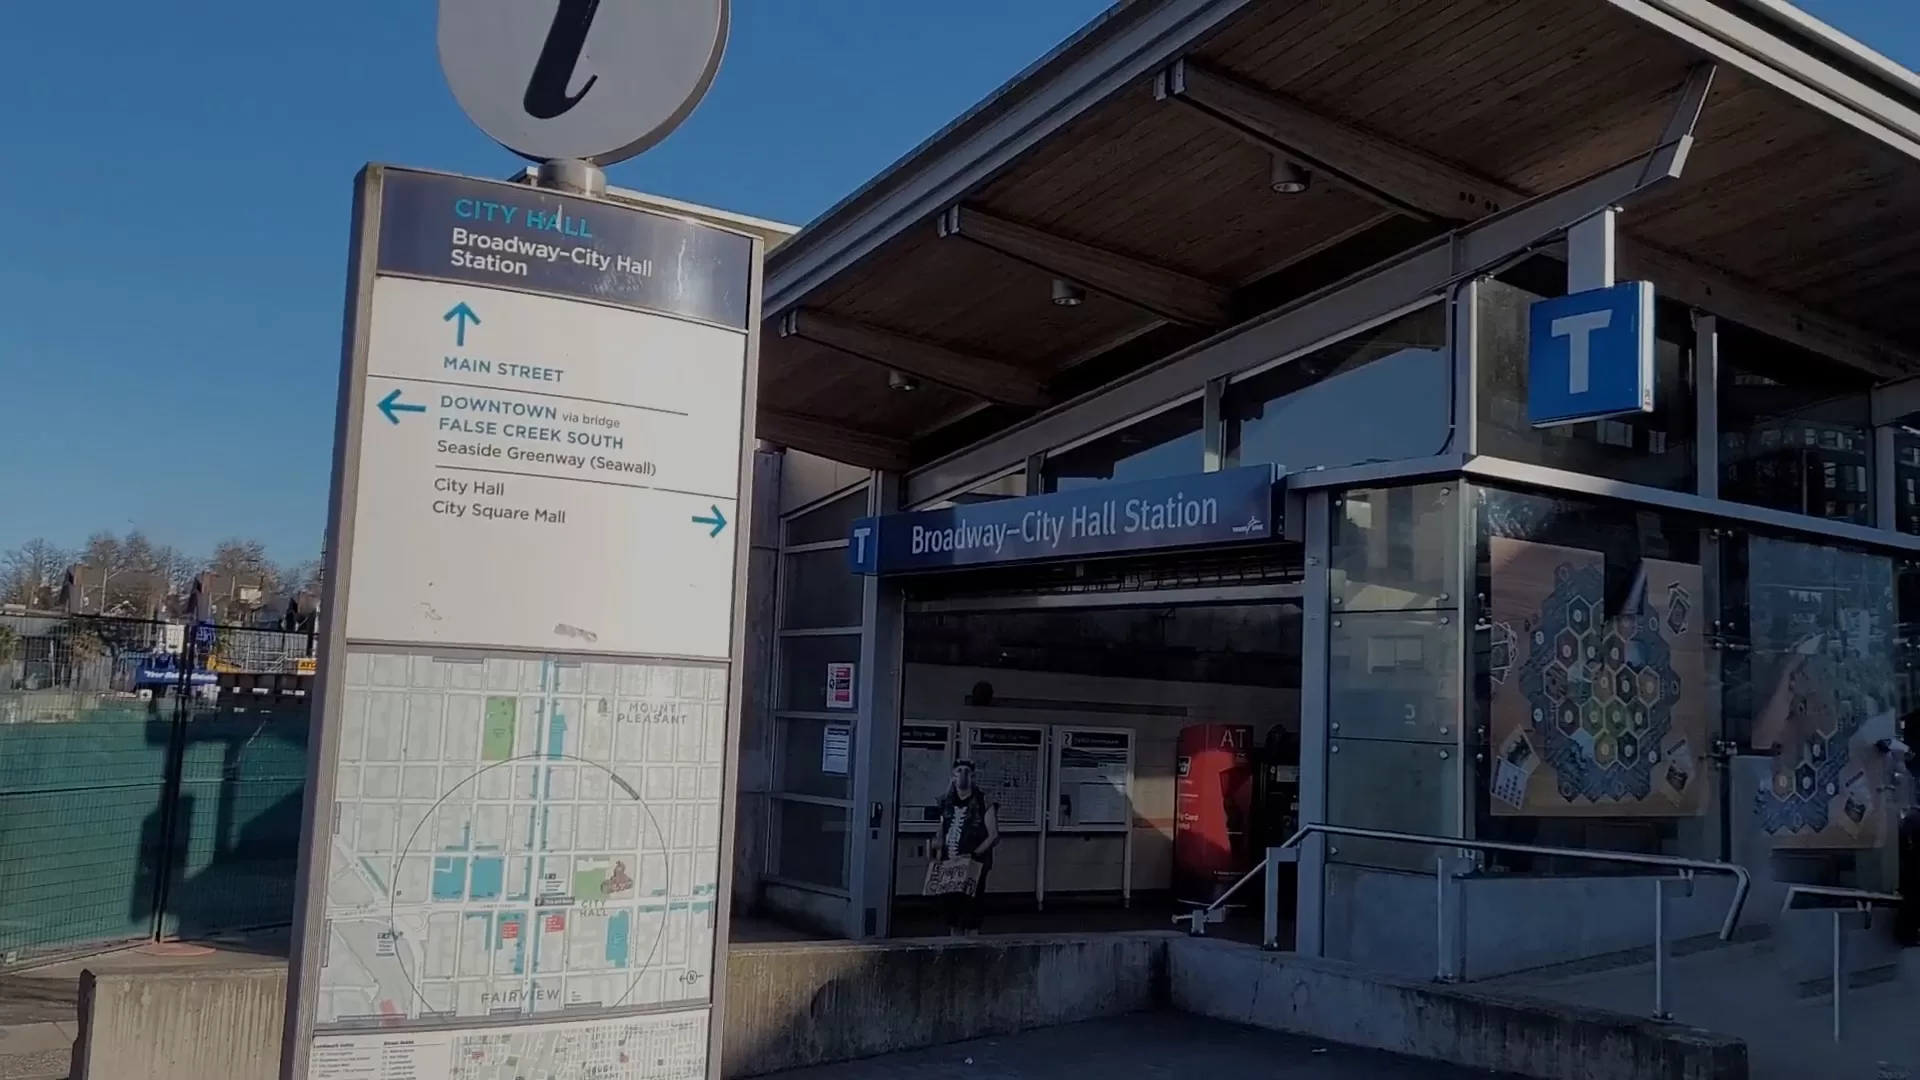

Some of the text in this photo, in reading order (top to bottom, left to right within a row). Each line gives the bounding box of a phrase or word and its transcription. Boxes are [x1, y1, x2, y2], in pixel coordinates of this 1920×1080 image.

[455, 197, 593, 237] CITY HALL
[450, 249, 528, 276] Station
[616, 254, 653, 278] Hall
[1551, 309, 1613, 394] T
[443, 355, 565, 383] MAIN STREET
[440, 395, 621, 429] DOWNTOWN via bridge
[438, 417, 624, 450] FALSE CREEK SOUTH
[437, 439, 657, 477] Seaside Greenway (Seawall)
[434, 477, 505, 497] City Hall
[432, 499, 566, 524] City Square Mall
[1070, 499, 1117, 539] Hall
[1124, 491, 1218, 533] Station
[853, 527, 870, 564] T
[617, 712, 688, 724] PLEASANT
[628, 702, 677, 713] MOUNT
[580, 907, 608, 917] HALL
[581, 899, 607, 908] CITY
[480, 988, 561, 1005] FAIRVIEW
